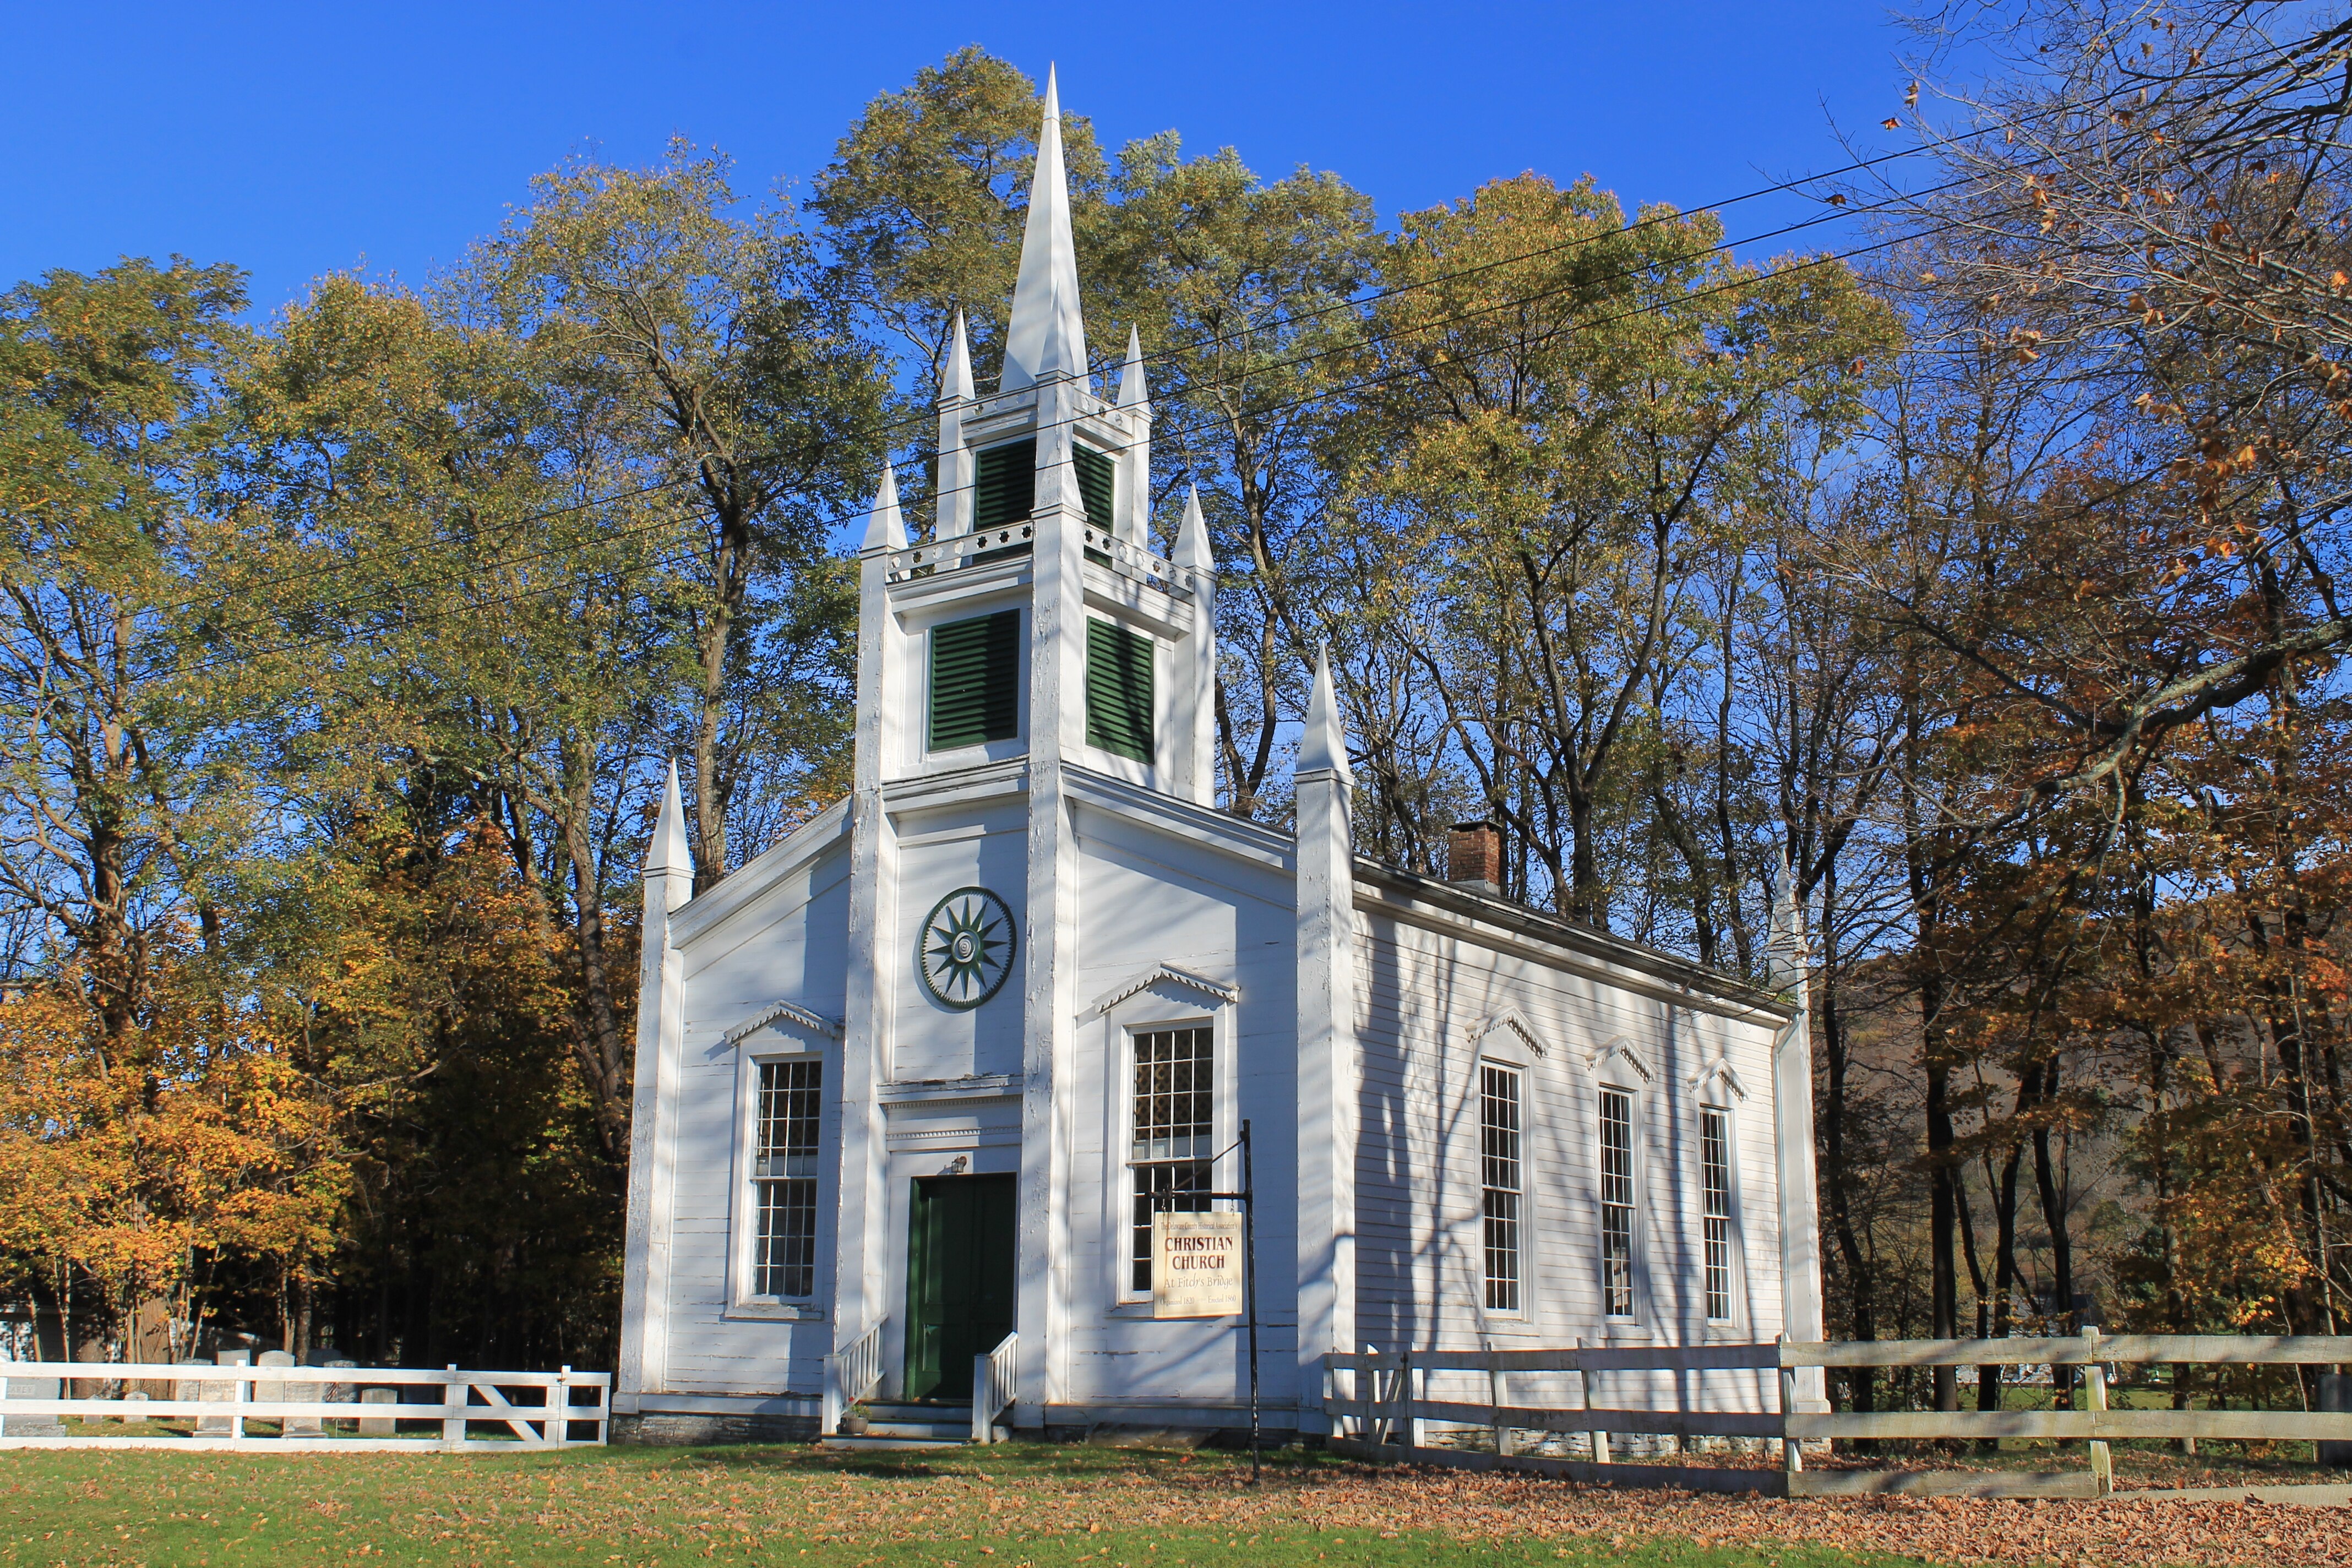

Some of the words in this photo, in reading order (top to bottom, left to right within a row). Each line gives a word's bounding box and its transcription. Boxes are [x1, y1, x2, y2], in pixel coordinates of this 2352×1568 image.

[1184, 1222, 1197, 1232] County
[1165, 1237, 1233, 1251] CHRISTIAN
[1173, 1255, 1224, 1270] CHURCH
[1164, 1278, 1175, 1288] At
[1178, 1272, 1205, 1288] Fitch's
[1207, 1275, 1233, 1289] Bridge
[1160, 1295, 1182, 1306] Organized
[1184, 1297, 1195, 1305] 1820
[1208, 1294, 1223, 1303] Erected
